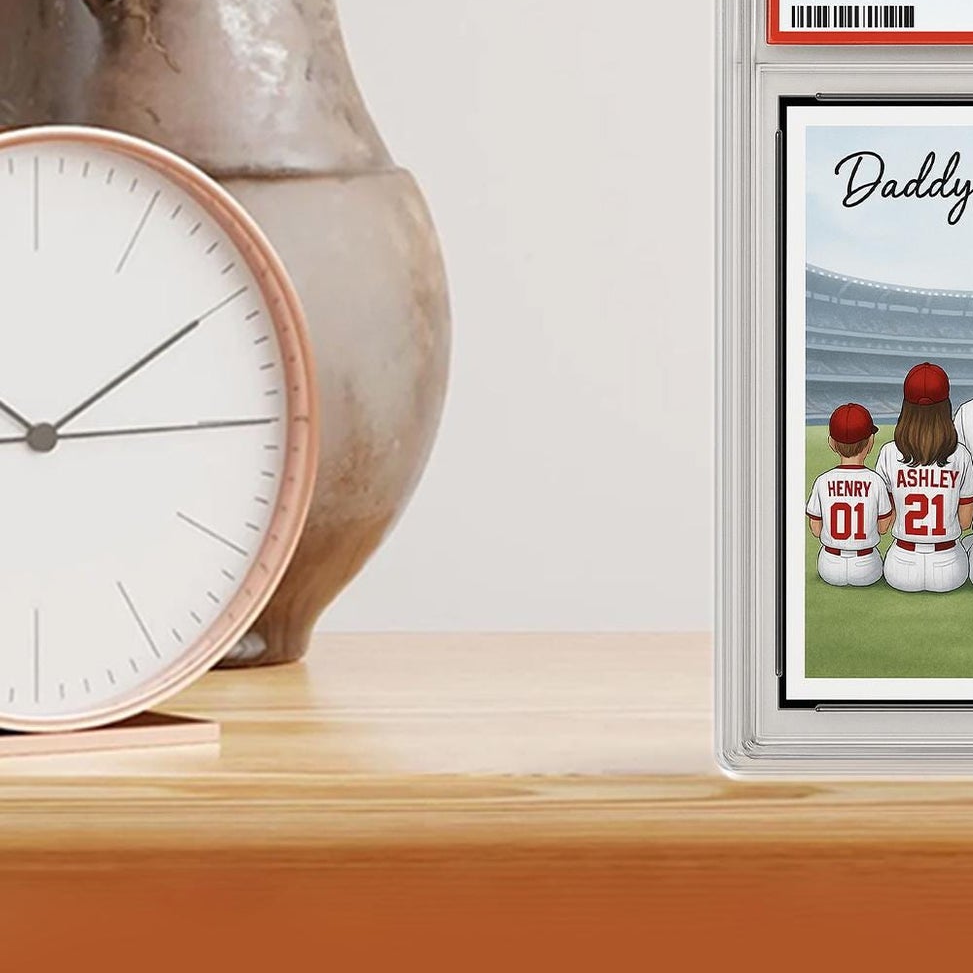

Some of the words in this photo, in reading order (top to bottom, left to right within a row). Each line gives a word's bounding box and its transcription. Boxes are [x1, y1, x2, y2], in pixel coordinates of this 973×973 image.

[828, 480, 871, 498] HENRY
[897, 468, 960, 489] ASHLEY
[831, 503, 865, 539] 01
[905, 494, 945, 535] 21
